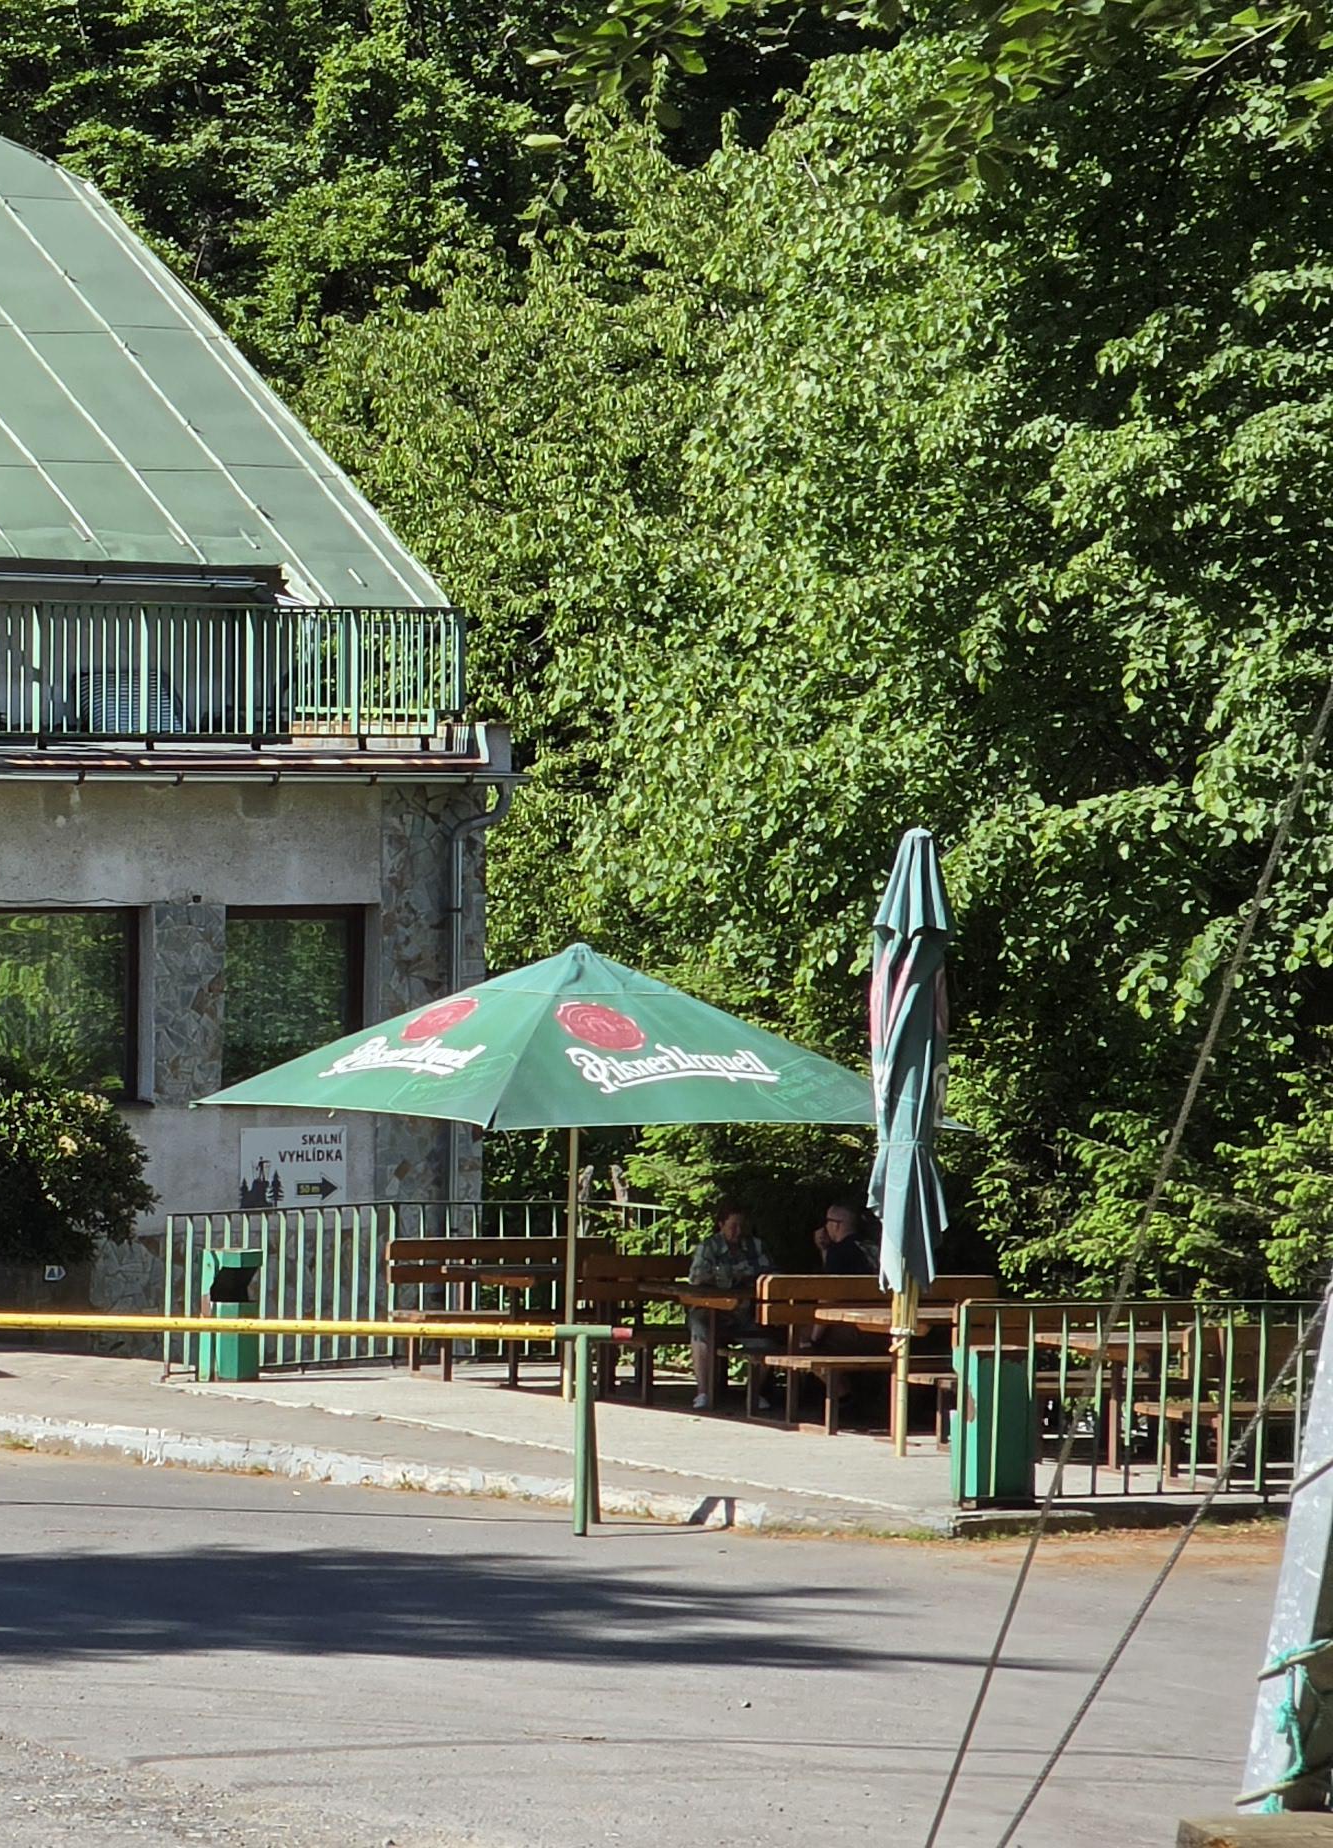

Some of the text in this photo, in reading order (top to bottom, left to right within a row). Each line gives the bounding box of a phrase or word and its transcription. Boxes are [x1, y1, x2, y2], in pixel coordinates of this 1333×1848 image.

[565, 1043, 781, 1094] Pilsner Urquell
[301, 1128, 344, 1145] SKALNÍ
[278, 1147, 343, 1163] VYHLÍDKA
